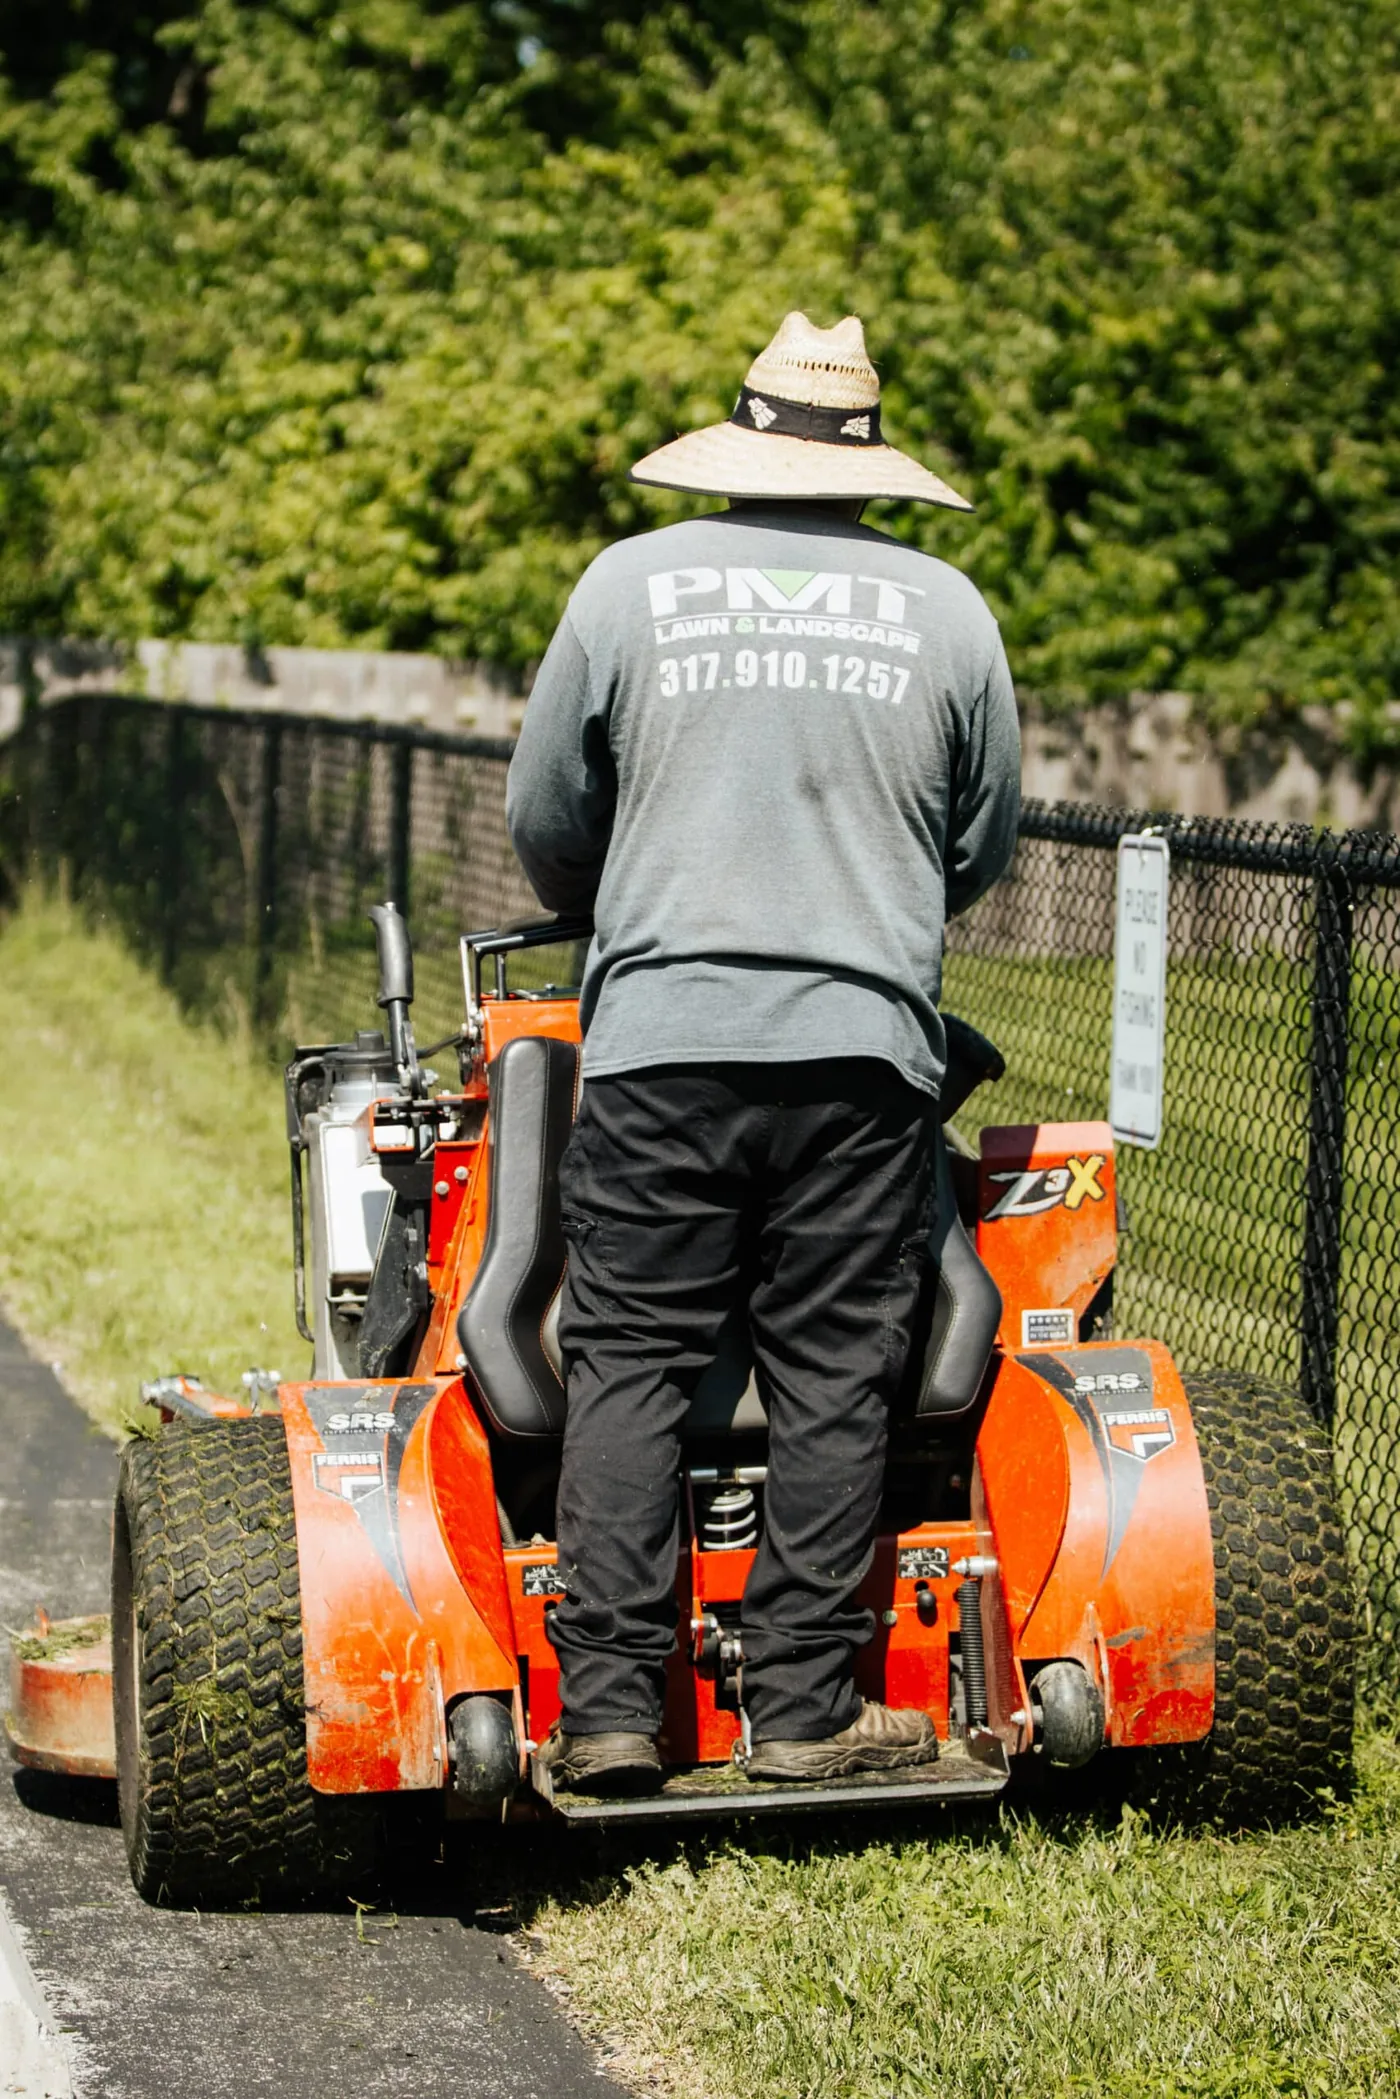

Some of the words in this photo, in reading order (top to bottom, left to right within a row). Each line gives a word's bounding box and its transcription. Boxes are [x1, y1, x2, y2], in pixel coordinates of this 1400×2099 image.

[648, 566, 926, 624] PMT
[654, 617, 730, 645] LAWN
[734, 616, 756, 634] &
[759, 617, 921, 655] LANDSCAPE
[658, 649, 910, 704] 317.910.1257
[1074, 1373, 1141, 1392] SRS
[327, 1411, 396, 1430] SRS
[1105, 1411, 1168, 1426] FERRIS
[316, 1454, 379, 1466] FERRIS
